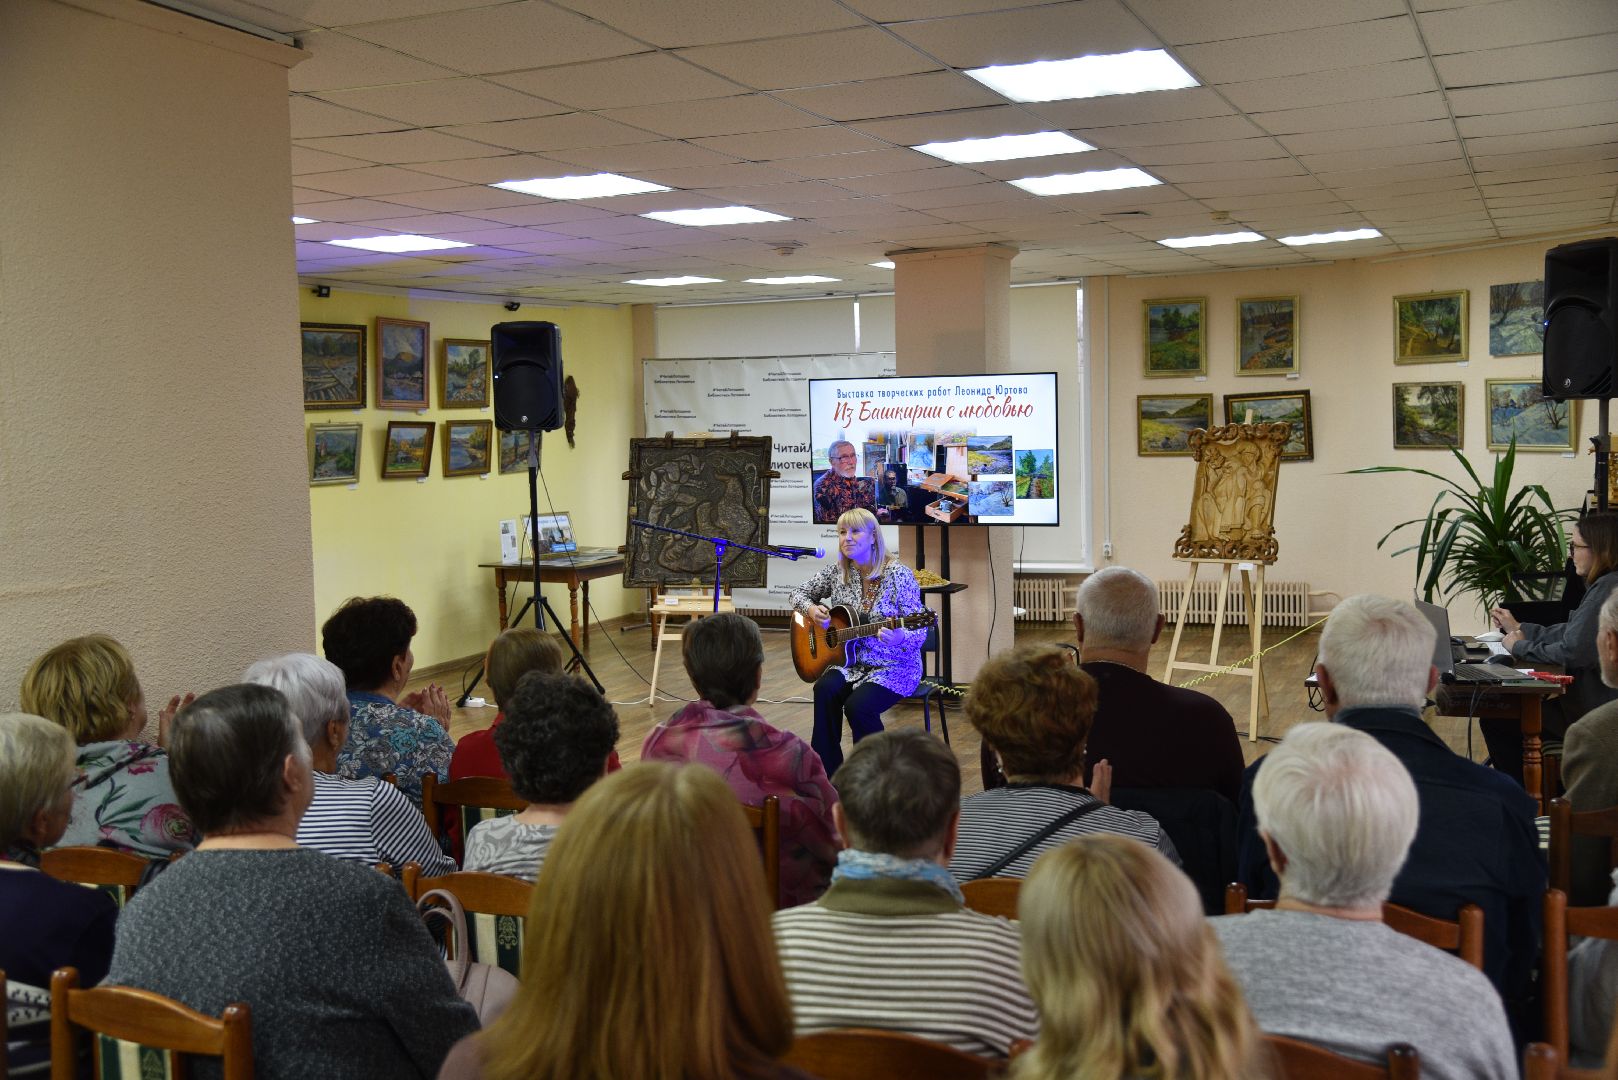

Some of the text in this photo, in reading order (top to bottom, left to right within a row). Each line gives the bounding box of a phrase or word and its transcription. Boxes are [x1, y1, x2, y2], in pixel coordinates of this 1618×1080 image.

[836, 384, 1028, 399] Выставка творческих работ Леонида Юртова
[834, 395, 1034, 429] Из Башкирии с любовью
